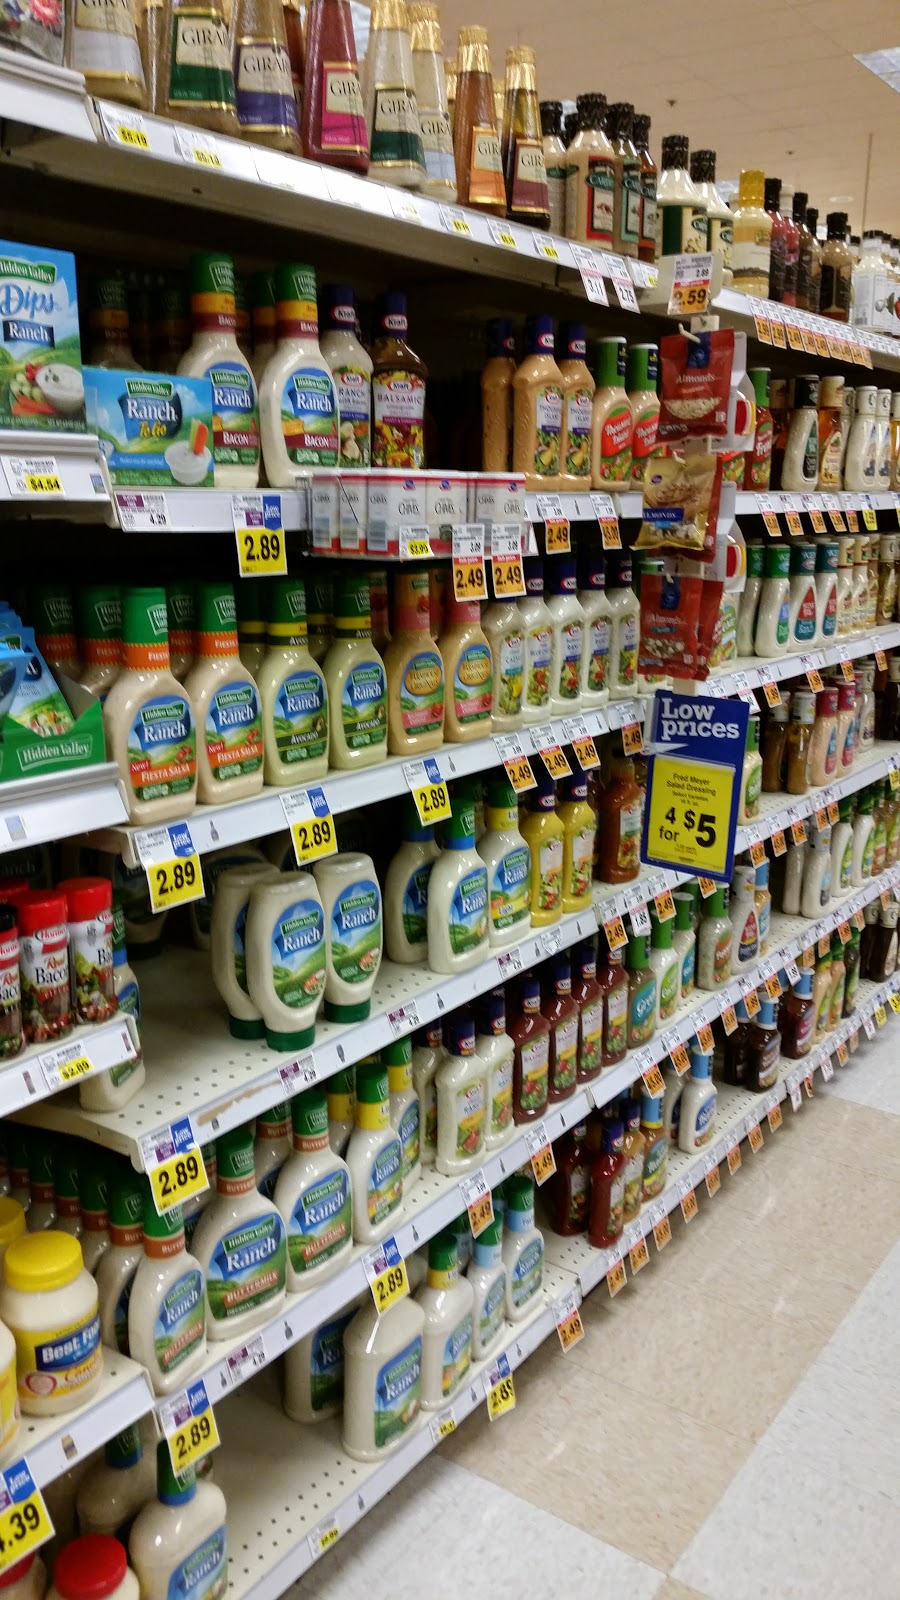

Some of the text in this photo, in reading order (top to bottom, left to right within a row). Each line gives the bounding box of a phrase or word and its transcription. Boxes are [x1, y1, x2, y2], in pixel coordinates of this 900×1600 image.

[1, 283, 55, 317] Dips
[9, 321, 49, 342] Ranch
[214, 389, 251, 409] Ranch
[297, 392, 332, 412] Ranch
[127, 399, 177, 421] Ranch
[223, 431, 249, 446] BACON
[304, 434, 329, 448] BACON
[548, 525, 568, 544] 2.49
[244, 534, 280, 561] 2.89
[455, 568, 484, 589] 2.49
[495, 565, 522, 585] 2.49
[353, 684, 382, 701] Ranch
[287, 695, 320, 713] Ranch
[661, 697, 716, 721] Low
[218, 707, 255, 726] Ranch
[143, 721, 187, 744] Ranch
[624, 731, 641, 748] 2.49
[661, 720, 740, 741] prices
[23, 740, 90, 763] Hidden Valley
[576, 745, 596, 761] 2.49
[544, 754, 567, 771] 2.49
[509, 764, 532, 783] 2.49
[673, 773, 710, 787] Fred Meyer
[666, 779, 717, 797] Salad Dressing
[419, 786, 447, 813] 2.89
[665, 806, 676, 824] 4
[299, 820, 331, 850] 2.89
[658, 824, 680, 843] for
[156, 860, 196, 896] 2.89
[342, 908, 377, 930] Ranch
[283, 927, 321, 952] Ranch
[607, 924, 624, 943] 2.49
[158, 1156, 199, 1197] 2.89
[304, 1192, 345, 1226] Ranch
[226, 1237, 276, 1273] Ranch
[227, 1272, 279, 1303] BUTTERMILK
[376, 1268, 403, 1302] 2.89
[167, 1289, 199, 1324] Ranch
[42, 1334, 80, 1364] Best
[386, 1363, 421, 1400] Ranch
[176, 1416, 211, 1460] 2.89
